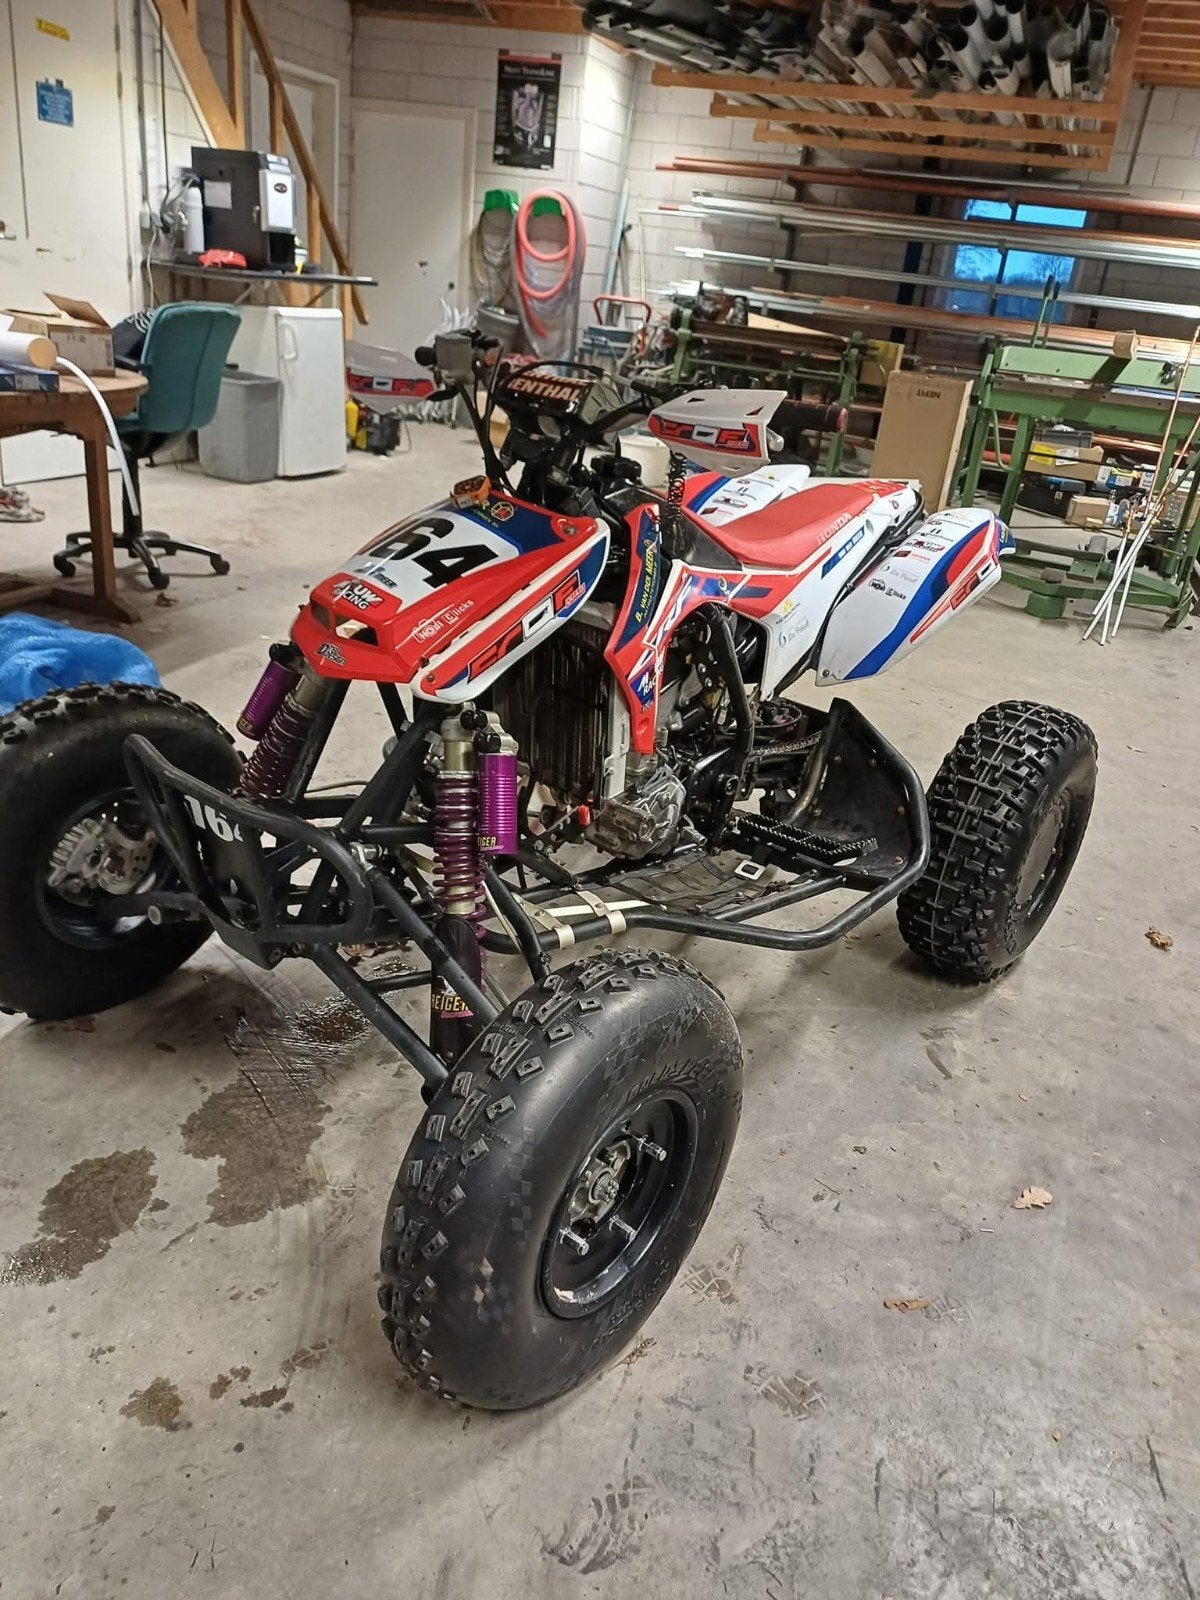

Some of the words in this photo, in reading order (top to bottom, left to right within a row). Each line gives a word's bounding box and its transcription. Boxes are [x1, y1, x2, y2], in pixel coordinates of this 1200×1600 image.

[817, 512, 853, 544] HONDA
[640, 590, 649, 608] VAN
[645, 549, 653, 574] MEER
